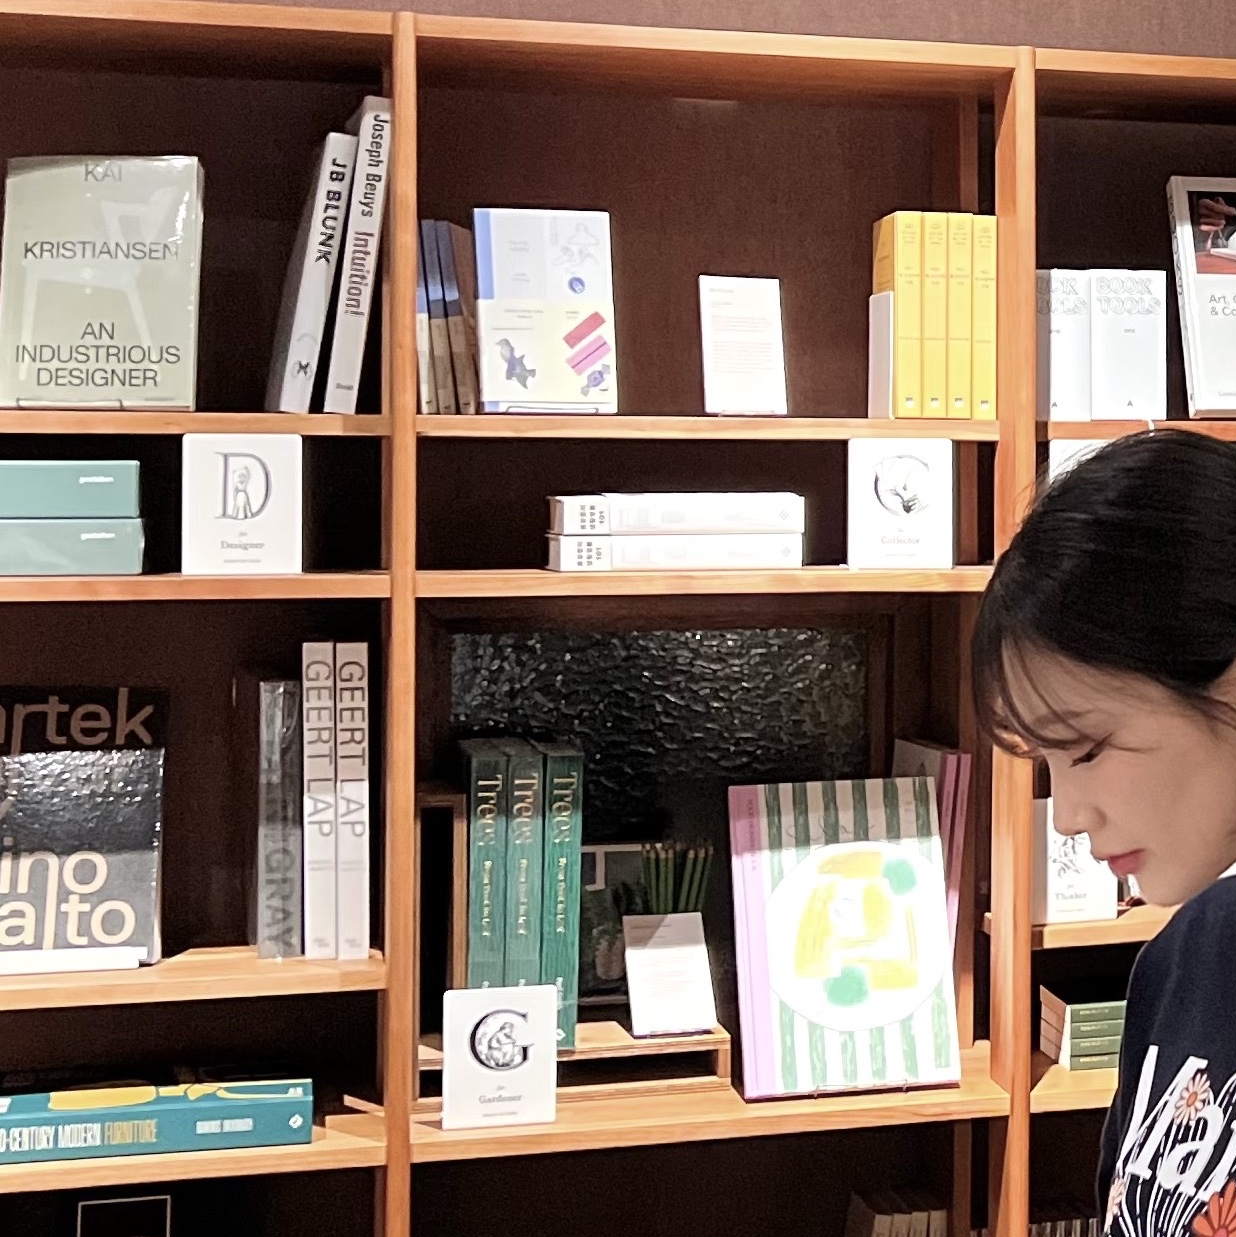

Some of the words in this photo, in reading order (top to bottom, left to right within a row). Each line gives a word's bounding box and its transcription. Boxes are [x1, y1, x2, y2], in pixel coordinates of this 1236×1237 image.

[367, 114, 390, 168] Joseph
[84, 162, 123, 182] KAI
[329, 157, 348, 183] JB
[361, 173, 383, 218] Beuys
[314, 189, 345, 264] BLUNK
[24, 241, 179, 261] KRISTIANSEN
[345, 231, 375, 317] Intuition!
[1096, 277, 1153, 295] BOOK
[1096, 296, 1161, 315] TOOLS
[1209, 294, 1230, 305] Art,
[1210, 307, 1219, 316] &
[81, 322, 115, 340] AN
[15, 345, 181, 364] INDUSTRIOUS
[36, 367, 158, 387] DESIGNER
[214, 451, 272, 520] D
[220, 540, 265, 551] Designer
[0, 687, 155, 755] rtek
[305, 660, 333, 766] GEERT
[338, 660, 366, 767] GEERT
[306, 778, 334, 838] LAP
[339, 778, 367, 838] LAP
[264, 850, 296, 949] GRAY
[469, 1008, 531, 1071] G
[478, 1093, 522, 1104] Gardener
[57, 1122, 102, 1148] MODERN
[104, 1119, 158, 1145] FURNITURE
